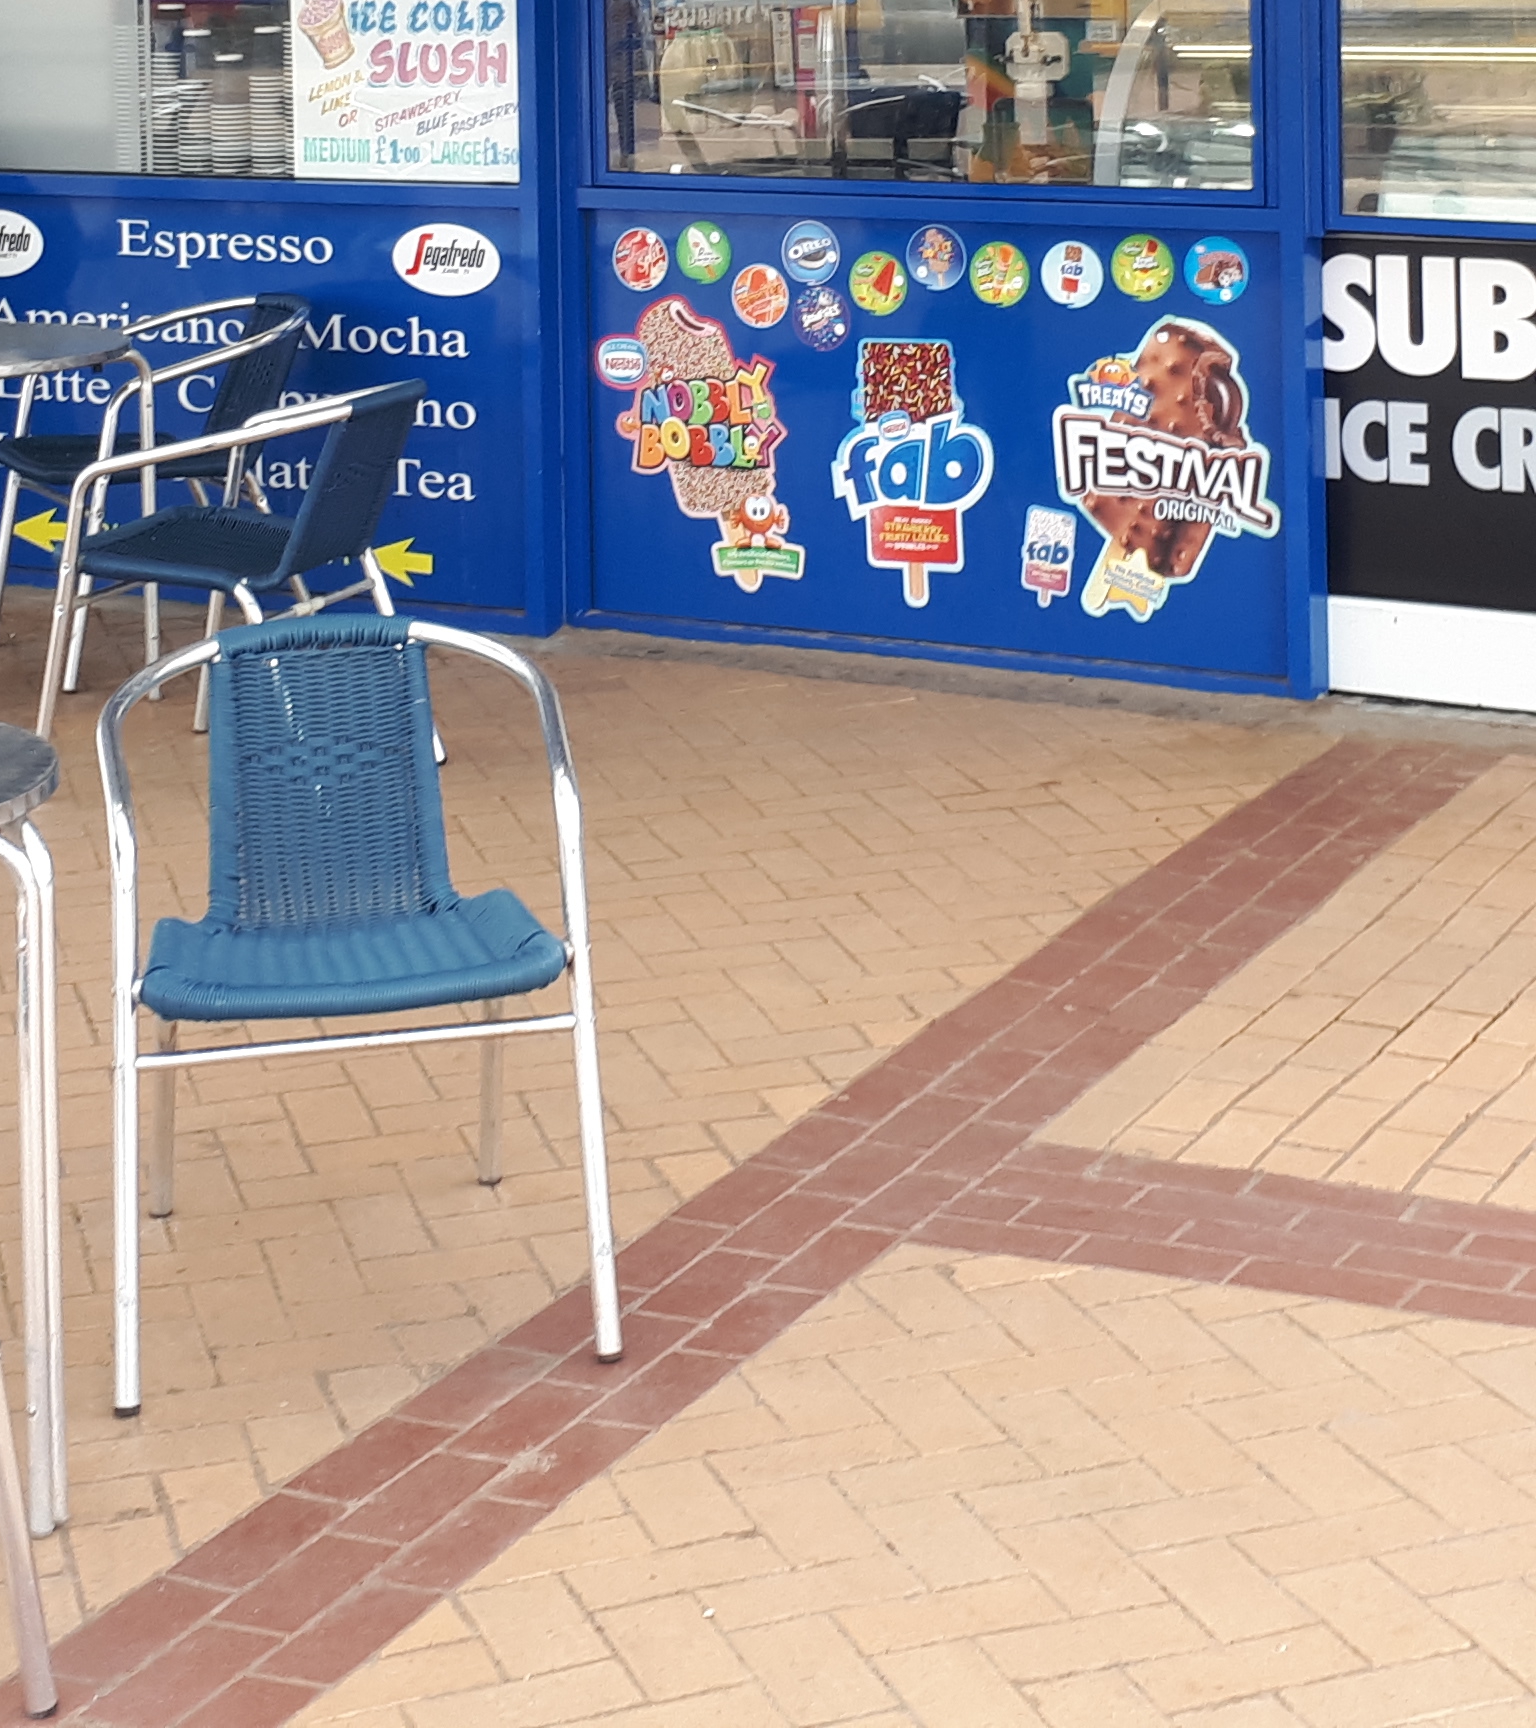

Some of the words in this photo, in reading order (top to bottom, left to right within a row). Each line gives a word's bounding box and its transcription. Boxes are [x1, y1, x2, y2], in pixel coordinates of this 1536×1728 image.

[349, 0, 397, 35] ICE
[407, 0, 505, 35] COLD
[368, 39, 507, 87] SLUSH
[308, 72, 351, 102] LEMON
[339, 110, 357, 127] OR
[375, 89, 462, 132] STRAWBERRY
[304, 137, 370, 163] MEDIUM
[430, 140, 481, 165] LARGE
[116, 219, 334, 269] Espresso
[405, 233, 486, 276] Segafredo
[788, 238, 831, 259] OREO
[1060, 260, 1083, 276] fab
[297, 314, 470, 359] Mocha
[642, 362, 769, 425] NOBBLY
[1078, 383, 1149, 417] TREATS
[639, 416, 781, 468] BOBBLY
[844, 422, 983, 504] fab
[1325, 398, 1430, 486] ICE
[392, 459, 475, 501] Tea
[1064, 417, 1268, 523] FESTIVAL
[1154, 499, 1236, 532] ORIGINAL
[1026, 540, 1069, 564] fab
